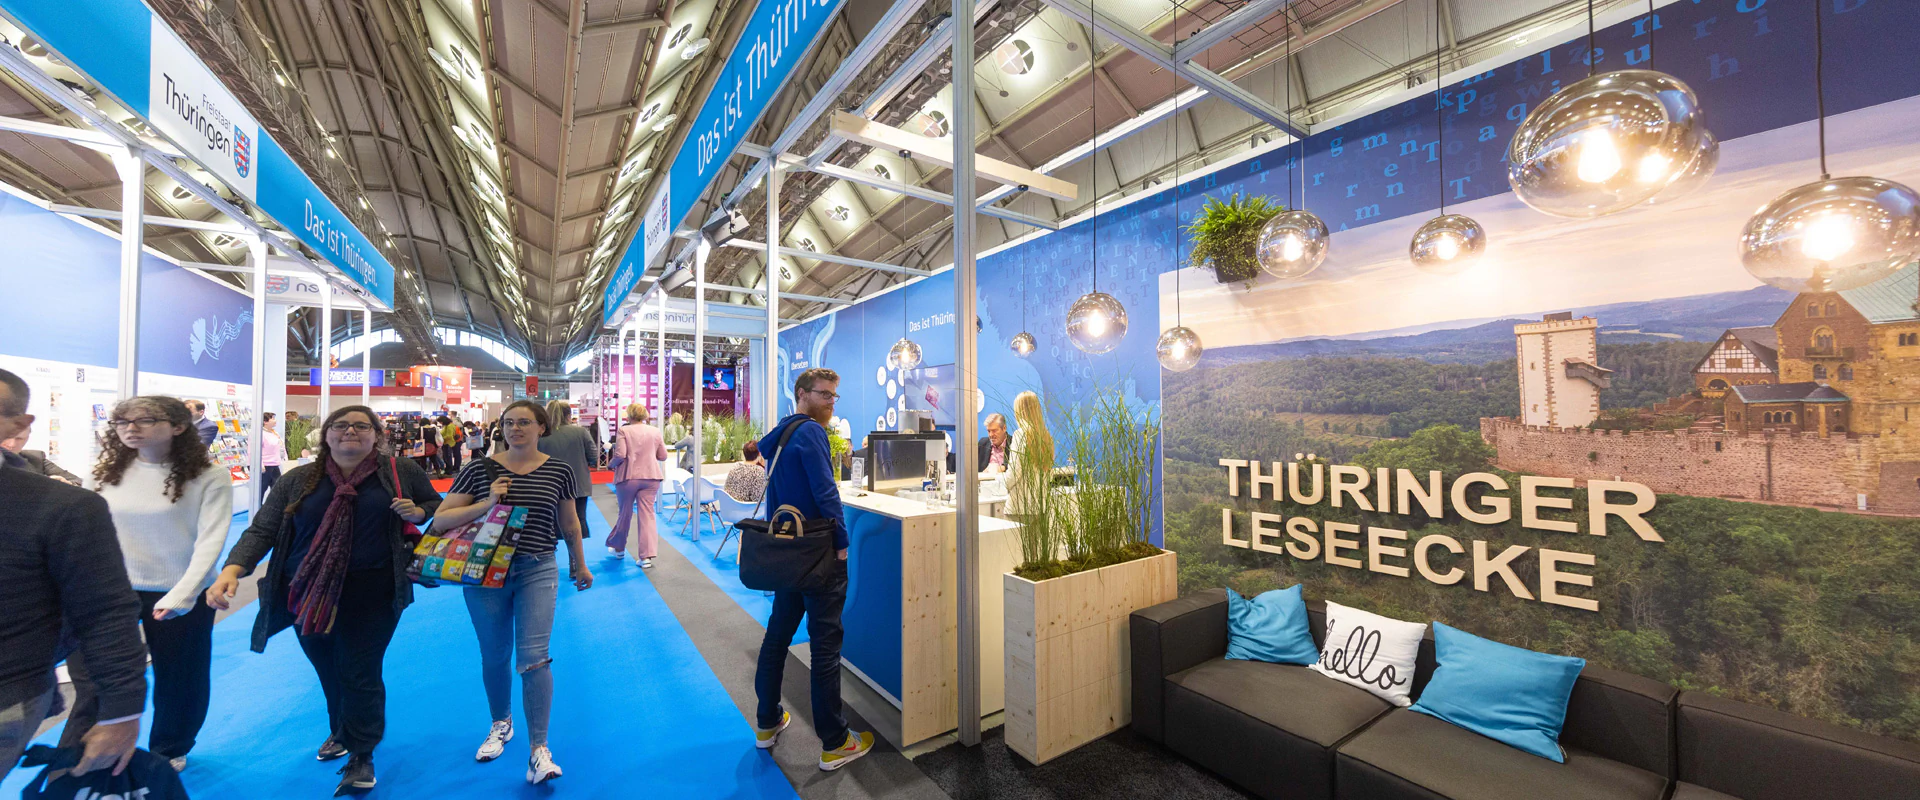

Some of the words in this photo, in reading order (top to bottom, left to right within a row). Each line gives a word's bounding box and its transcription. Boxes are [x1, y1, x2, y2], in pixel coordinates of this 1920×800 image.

[1631, 14, 1663, 38] n
[1693, 16, 1717, 40] r
[1753, 9, 1773, 37] i
[1540, 51, 1554, 75] l
[1583, 48, 1604, 65] e
[1624, 44, 1650, 66] u
[1706, 53, 1742, 82] h
[1457, 90, 1476, 114] p
[1516, 81, 1544, 100] w
[163, 72, 231, 157] Thüringen
[203, 94, 231, 132] Freistaat
[1507, 104, 1527, 127] q
[698, 118, 720, 177] Das
[724, 74, 742, 138] ist
[1478, 126, 1497, 141] a
[1331, 136, 1343, 157] g
[1361, 132, 1388, 150] m
[1400, 140, 1418, 156] n
[1422, 140, 1440, 163] T
[1285, 156, 1296, 170] z
[1384, 164, 1398, 177] e
[1313, 172, 1324, 186] r
[1386, 183, 1404, 197] n
[1450, 176, 1471, 199] T
[1346, 184, 1358, 198] r
[1355, 204, 1380, 221] m
[305, 198, 325, 243] Das
[328, 219, 339, 256] ist
[340, 232, 378, 287] Thüringen.
[909, 321, 920, 332] Das
[922, 318, 930, 329] ist
[1218, 452, 1665, 542] THÜRINGER
[1222, 508, 1599, 612] LESEECKE
[1318, 618, 1407, 690] hello
